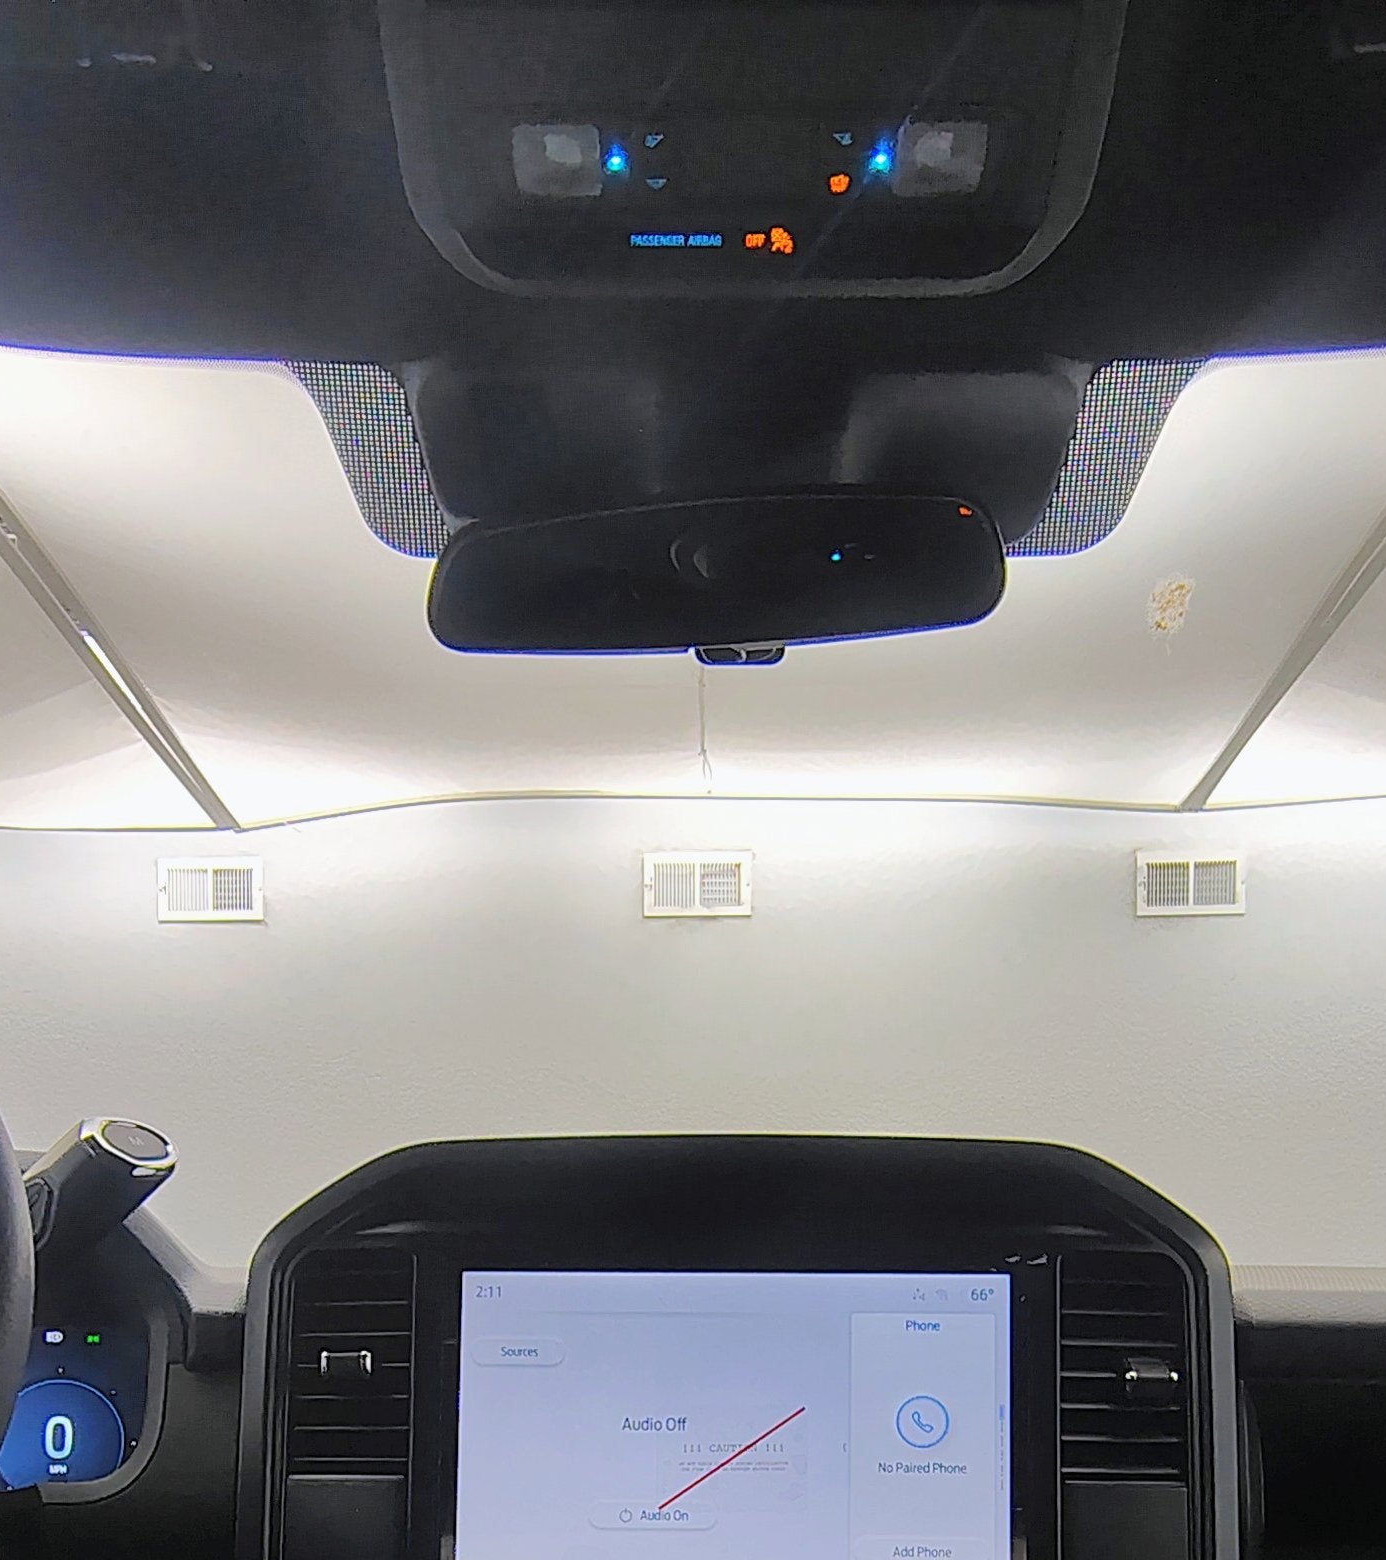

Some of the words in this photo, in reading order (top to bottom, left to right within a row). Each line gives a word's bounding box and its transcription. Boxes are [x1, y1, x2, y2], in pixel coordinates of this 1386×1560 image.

[630, 234, 685, 247] PASSENGER
[687, 234, 723, 247] AIRBAG
[745, 233, 766, 248] OFF
[476, 1286, 502, 1298] 2:11
[971, 1288, 995, 1301] 66°
[905, 1320, 941, 1332] Phone
[500, 1346, 539, 1357] Sources
[622, 1417, 663, 1431] Audio
[665, 1416, 687, 1431] Off
[45, 1415, 73, 1459] 0
[878, 1462, 894, 1473] No
[896, 1461, 930, 1474] Paired
[932, 1462, 968, 1474] Phone
[673, 1510, 689, 1521] On
[893, 1547, 915, 1558] Add
[917, 1546, 952, 1558] Phone
